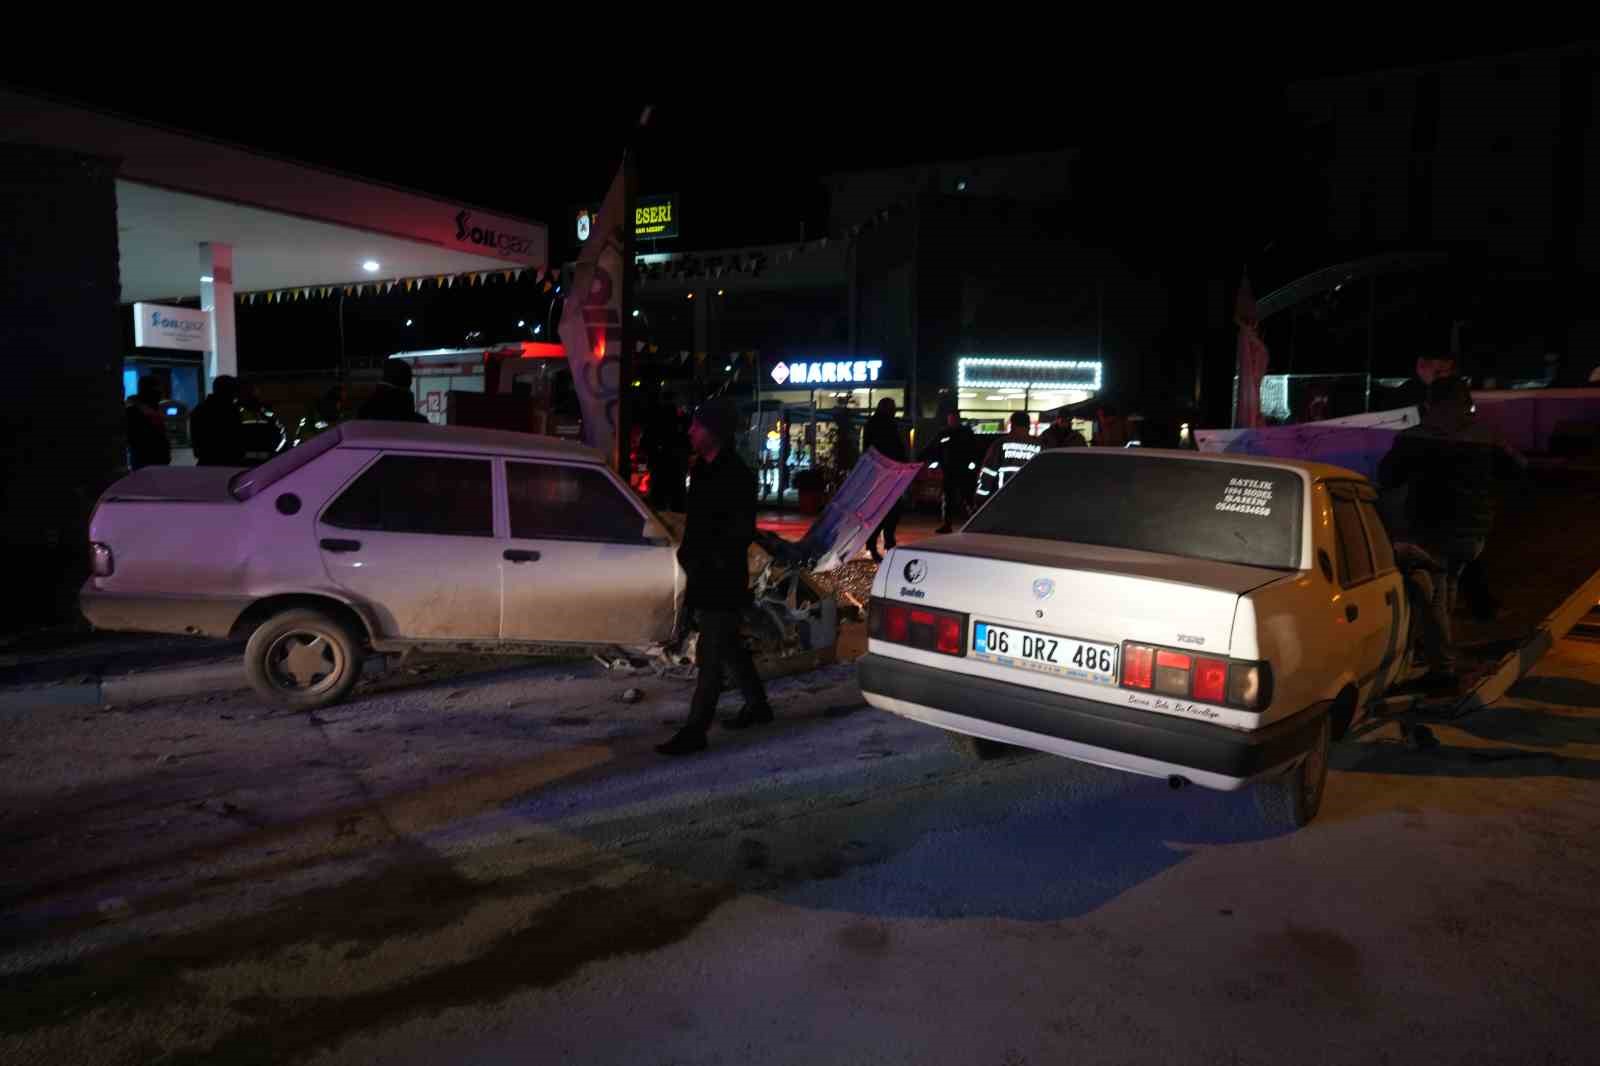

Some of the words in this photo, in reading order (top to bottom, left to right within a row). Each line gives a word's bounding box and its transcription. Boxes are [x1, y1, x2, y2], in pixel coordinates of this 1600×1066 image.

[635, 201, 671, 225] ESERİ
[789, 360, 882, 383] MARKET
[987, 629, 1009, 653] 06
[1022, 635, 1059, 664] DRZ
[1072, 645, 1111, 672] 486
